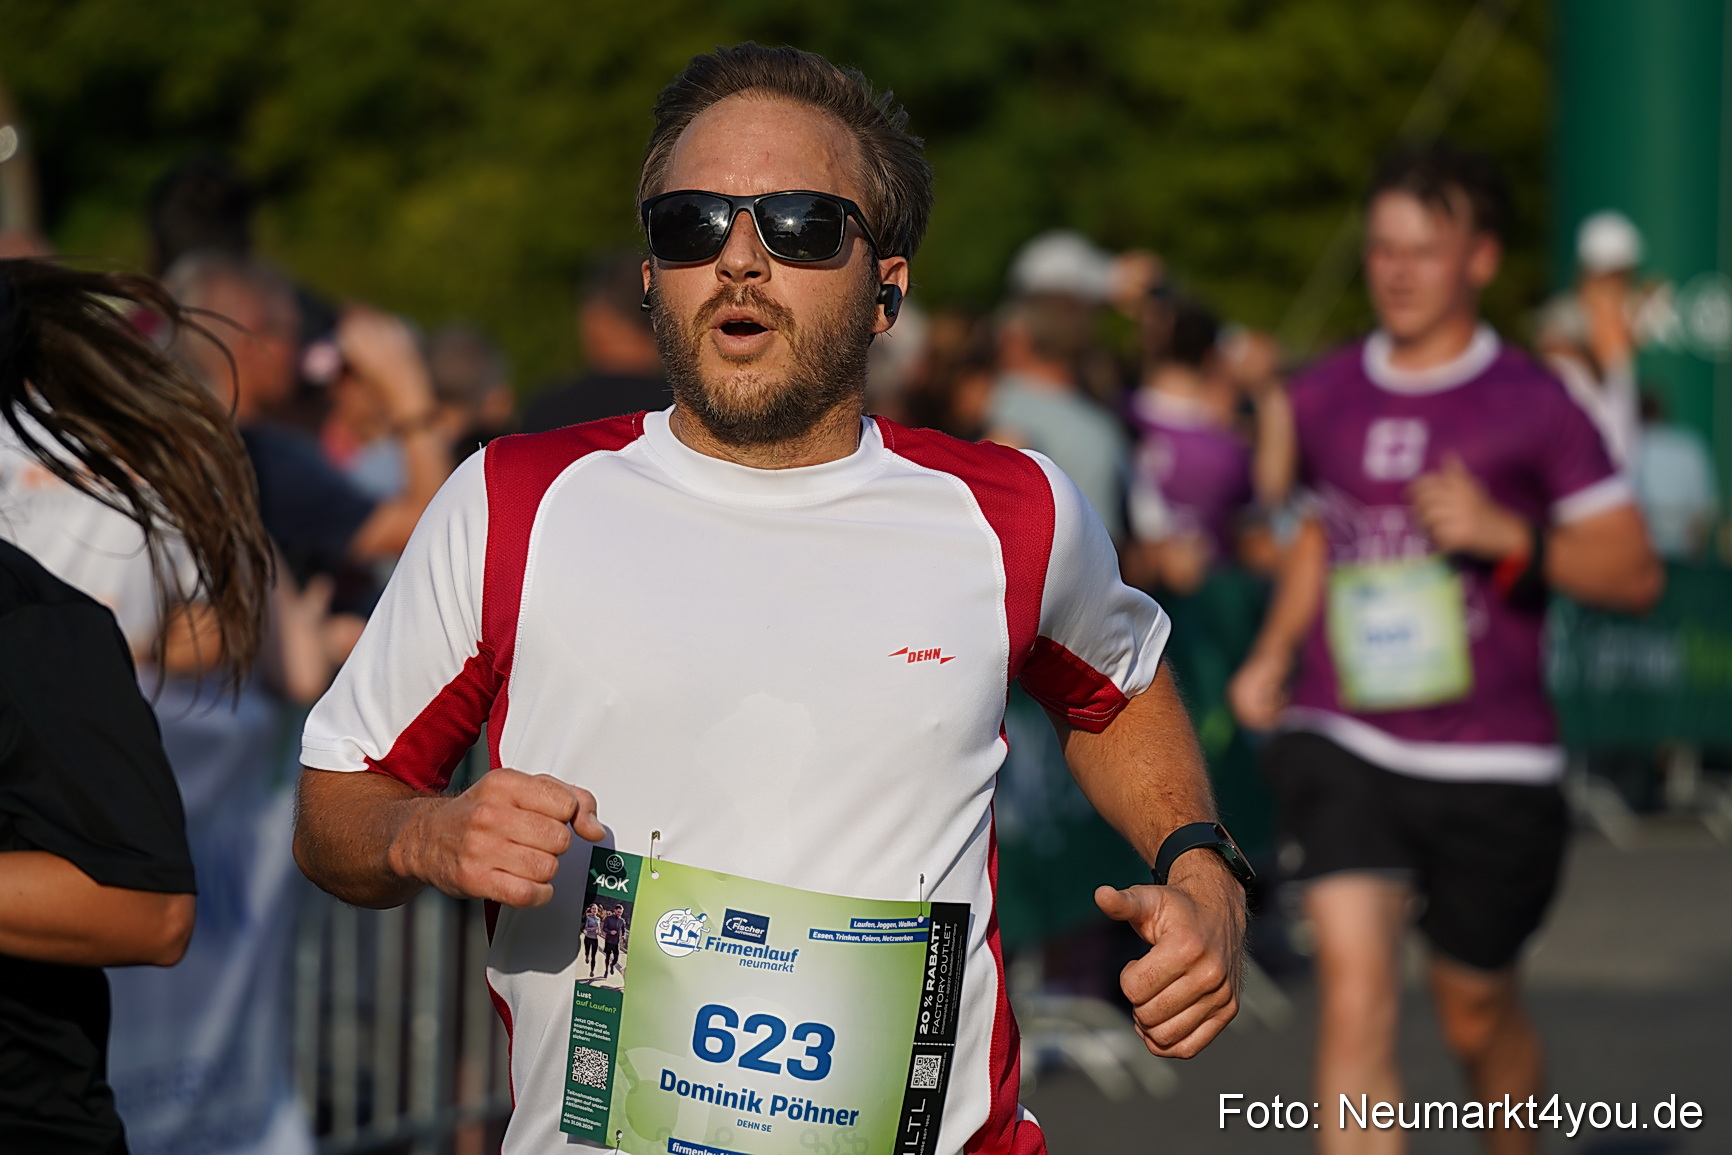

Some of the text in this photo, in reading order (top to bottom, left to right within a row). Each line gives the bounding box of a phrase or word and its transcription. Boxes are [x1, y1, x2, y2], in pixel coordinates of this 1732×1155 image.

[907, 647, 941, 663] DEHN
[593, 873, 630, 893] AOK
[732, 920, 765, 935] Fischer
[853, 920, 876, 929] Laufen,
[876, 921, 898, 930] Joggen,
[813, 931, 914, 942] Essen, Trinken, Feiern, Netzwerken
[705, 936, 799, 963] Firmenlauf
[739, 958, 794, 973] neumarkt
[919, 921, 941, 1035] 20 % RABATT
[932, 975, 946, 1034] FACTORY
[940, 922, 952, 974] OUTLET
[576, 990, 592, 999] Lust
[590, 1002, 617, 1014] Laufen?
[692, 1003, 836, 1081] 623
[660, 1068, 860, 1126] Dominik Pöhner
[736, 1118, 773, 1132] DEHN SE
